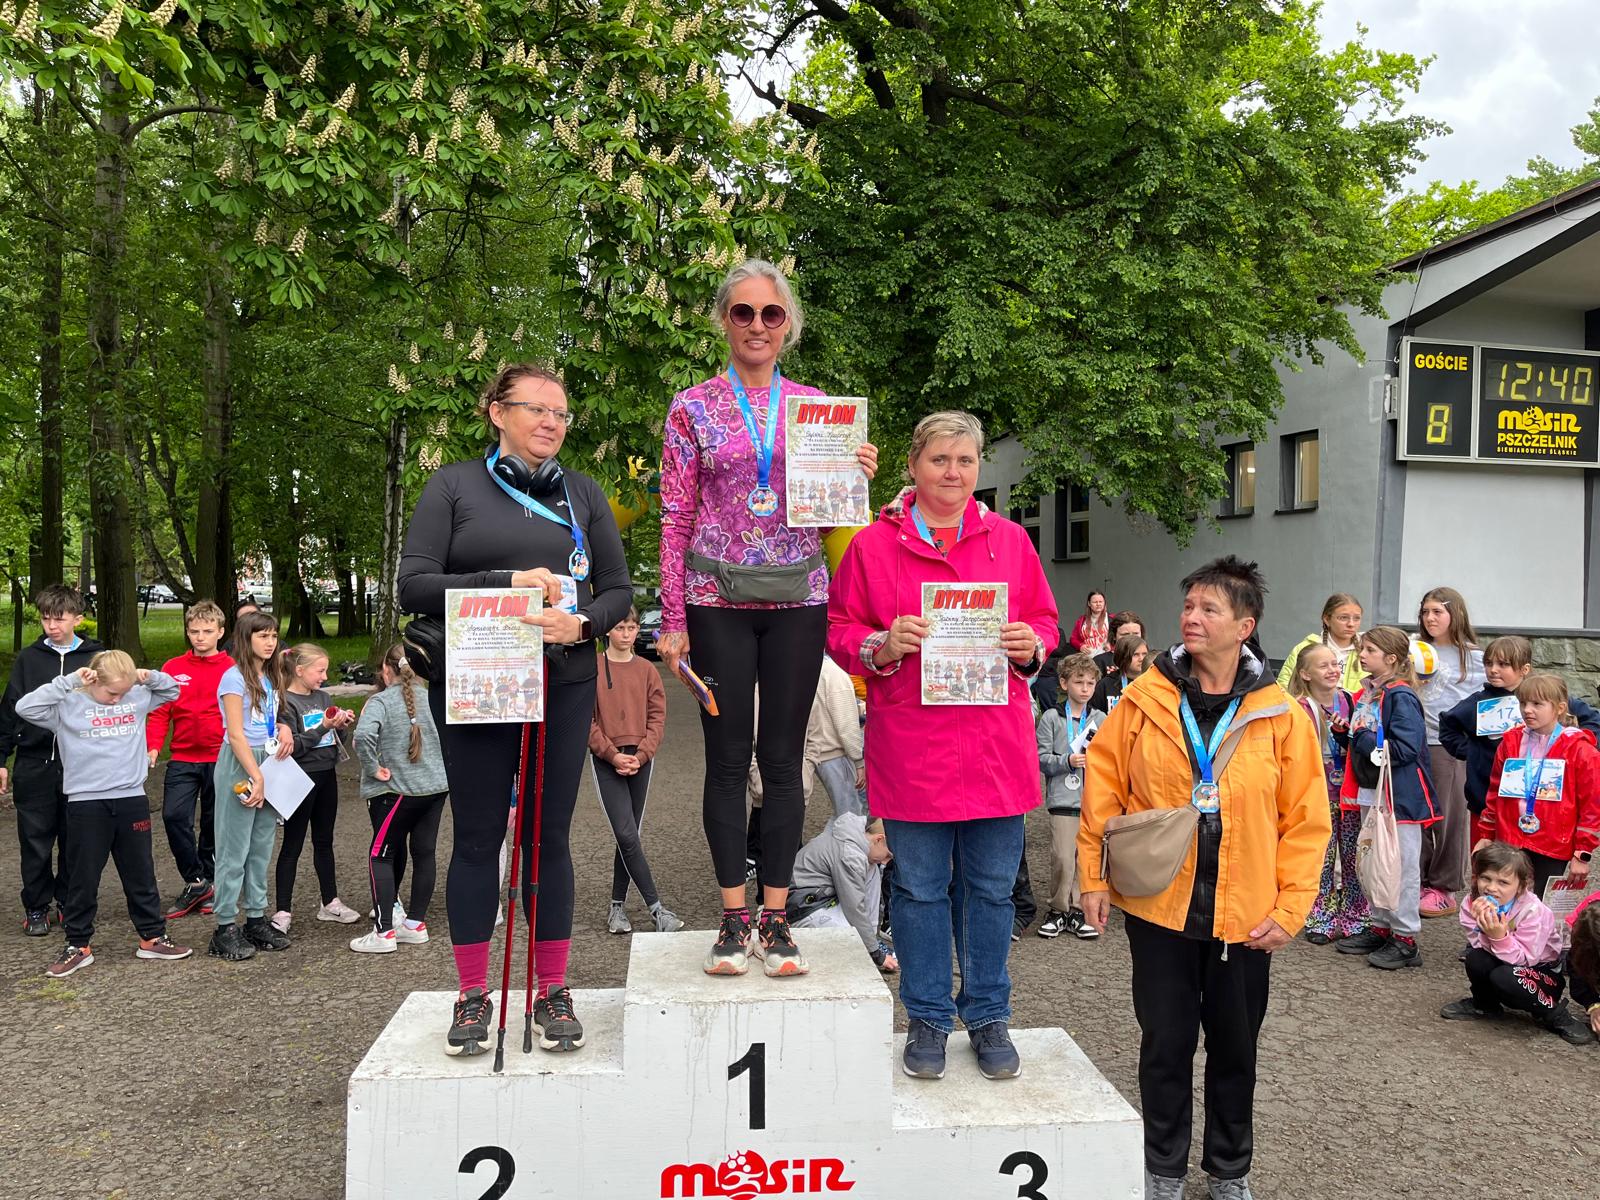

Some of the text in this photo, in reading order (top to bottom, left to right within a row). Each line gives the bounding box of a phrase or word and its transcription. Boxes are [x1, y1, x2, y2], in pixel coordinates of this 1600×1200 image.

[1415, 352, 1468, 371] GOŚCIE
[1498, 363, 1592, 404] 12:40
[797, 404, 857, 425] DYPLOM
[1426, 405, 1450, 444] 8
[1497, 433, 1577, 449] PSZCZELNIK
[1497, 446, 1546, 455] SIEMIANOWICE
[459, 596, 529, 617] DYPLOM
[933, 590, 997, 611] DYPLOM
[85, 702, 137, 718] street
[91, 714, 135, 727] dance
[1497, 707, 1514, 720] 17
[727, 1042, 765, 1130] 1
[458, 1145, 516, 1200] 2
[998, 1151, 1049, 1200] 3
